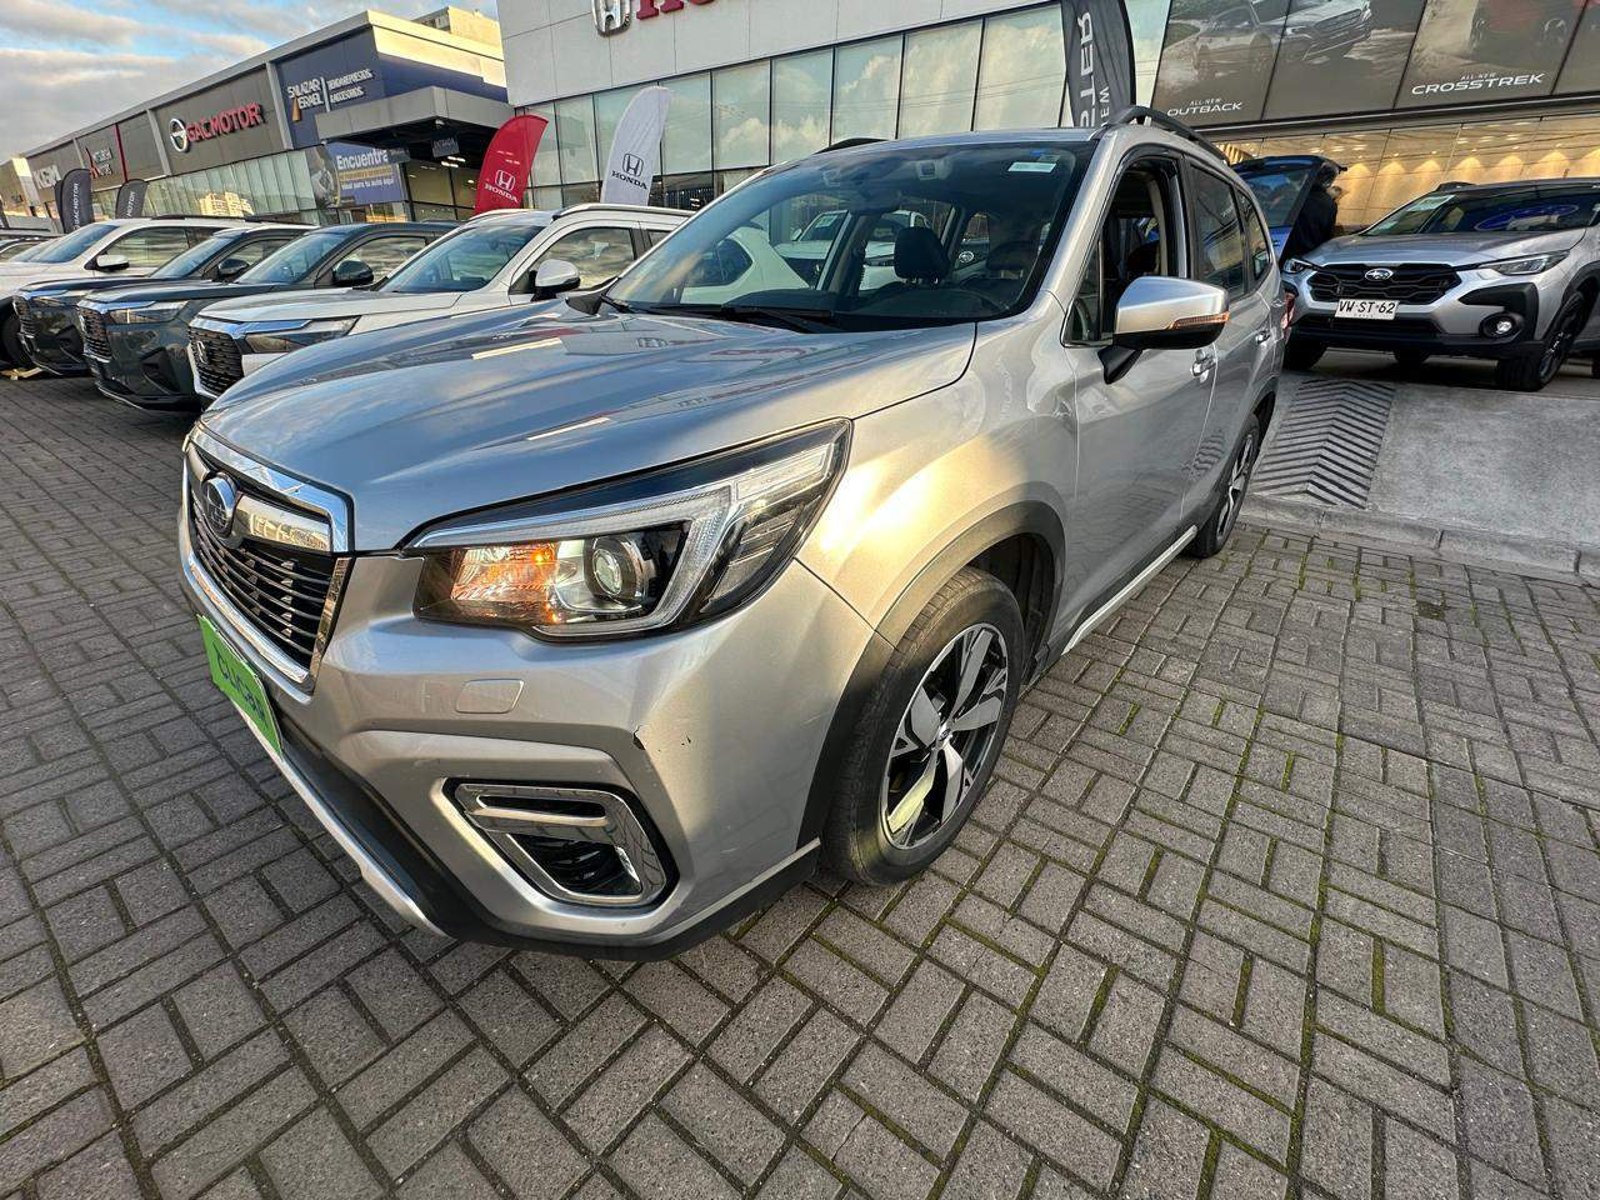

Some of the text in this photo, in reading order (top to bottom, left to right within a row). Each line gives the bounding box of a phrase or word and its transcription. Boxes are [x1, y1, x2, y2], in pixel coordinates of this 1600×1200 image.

[1411, 73, 1545, 95] CROSSTREK
[1167, 102, 1243, 117] OUTBACK
[1190, 98, 1222, 106] ALL-NEW
[610, 170, 648, 190] HONDA
[484, 183, 518, 203] HONDA
